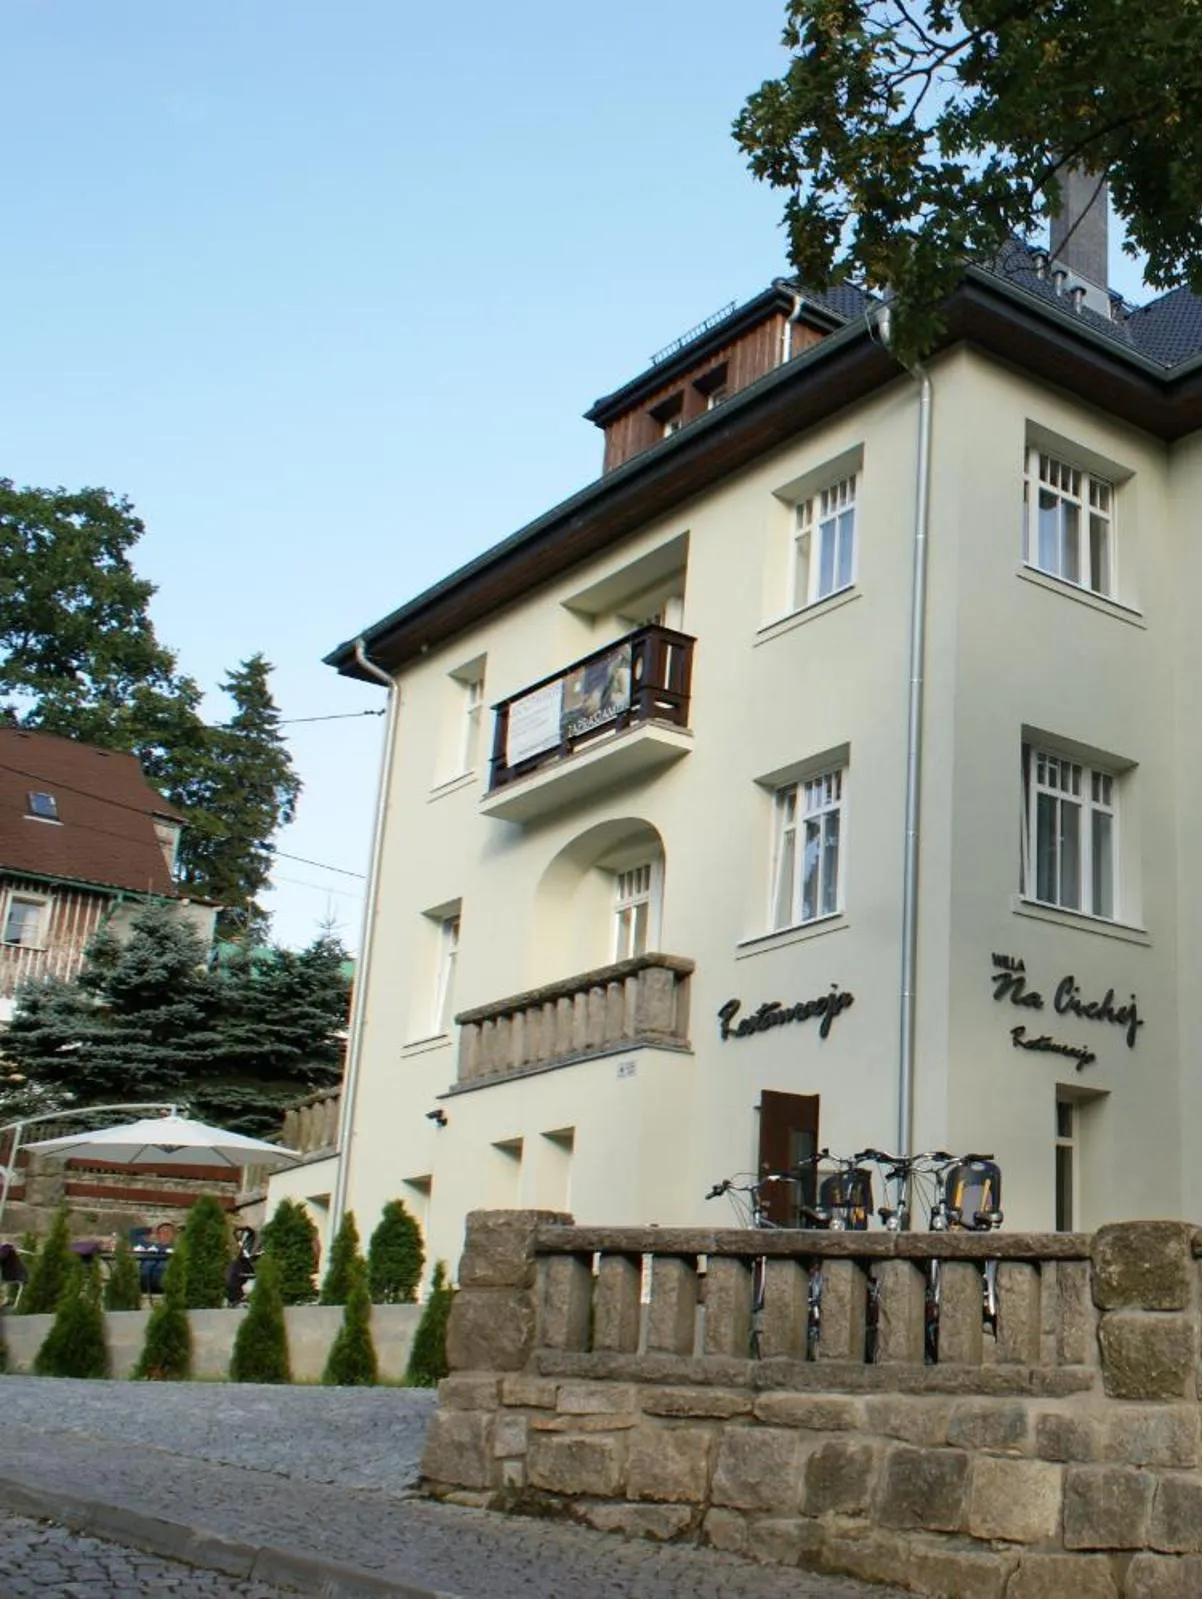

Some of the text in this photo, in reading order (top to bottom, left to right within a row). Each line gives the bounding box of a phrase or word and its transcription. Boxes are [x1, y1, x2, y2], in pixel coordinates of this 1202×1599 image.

[717, 983, 855, 1041] Restauracja
[991, 972, 1145, 1049] Na Cichej
[1010, 1025, 1097, 1073] Restauracja
